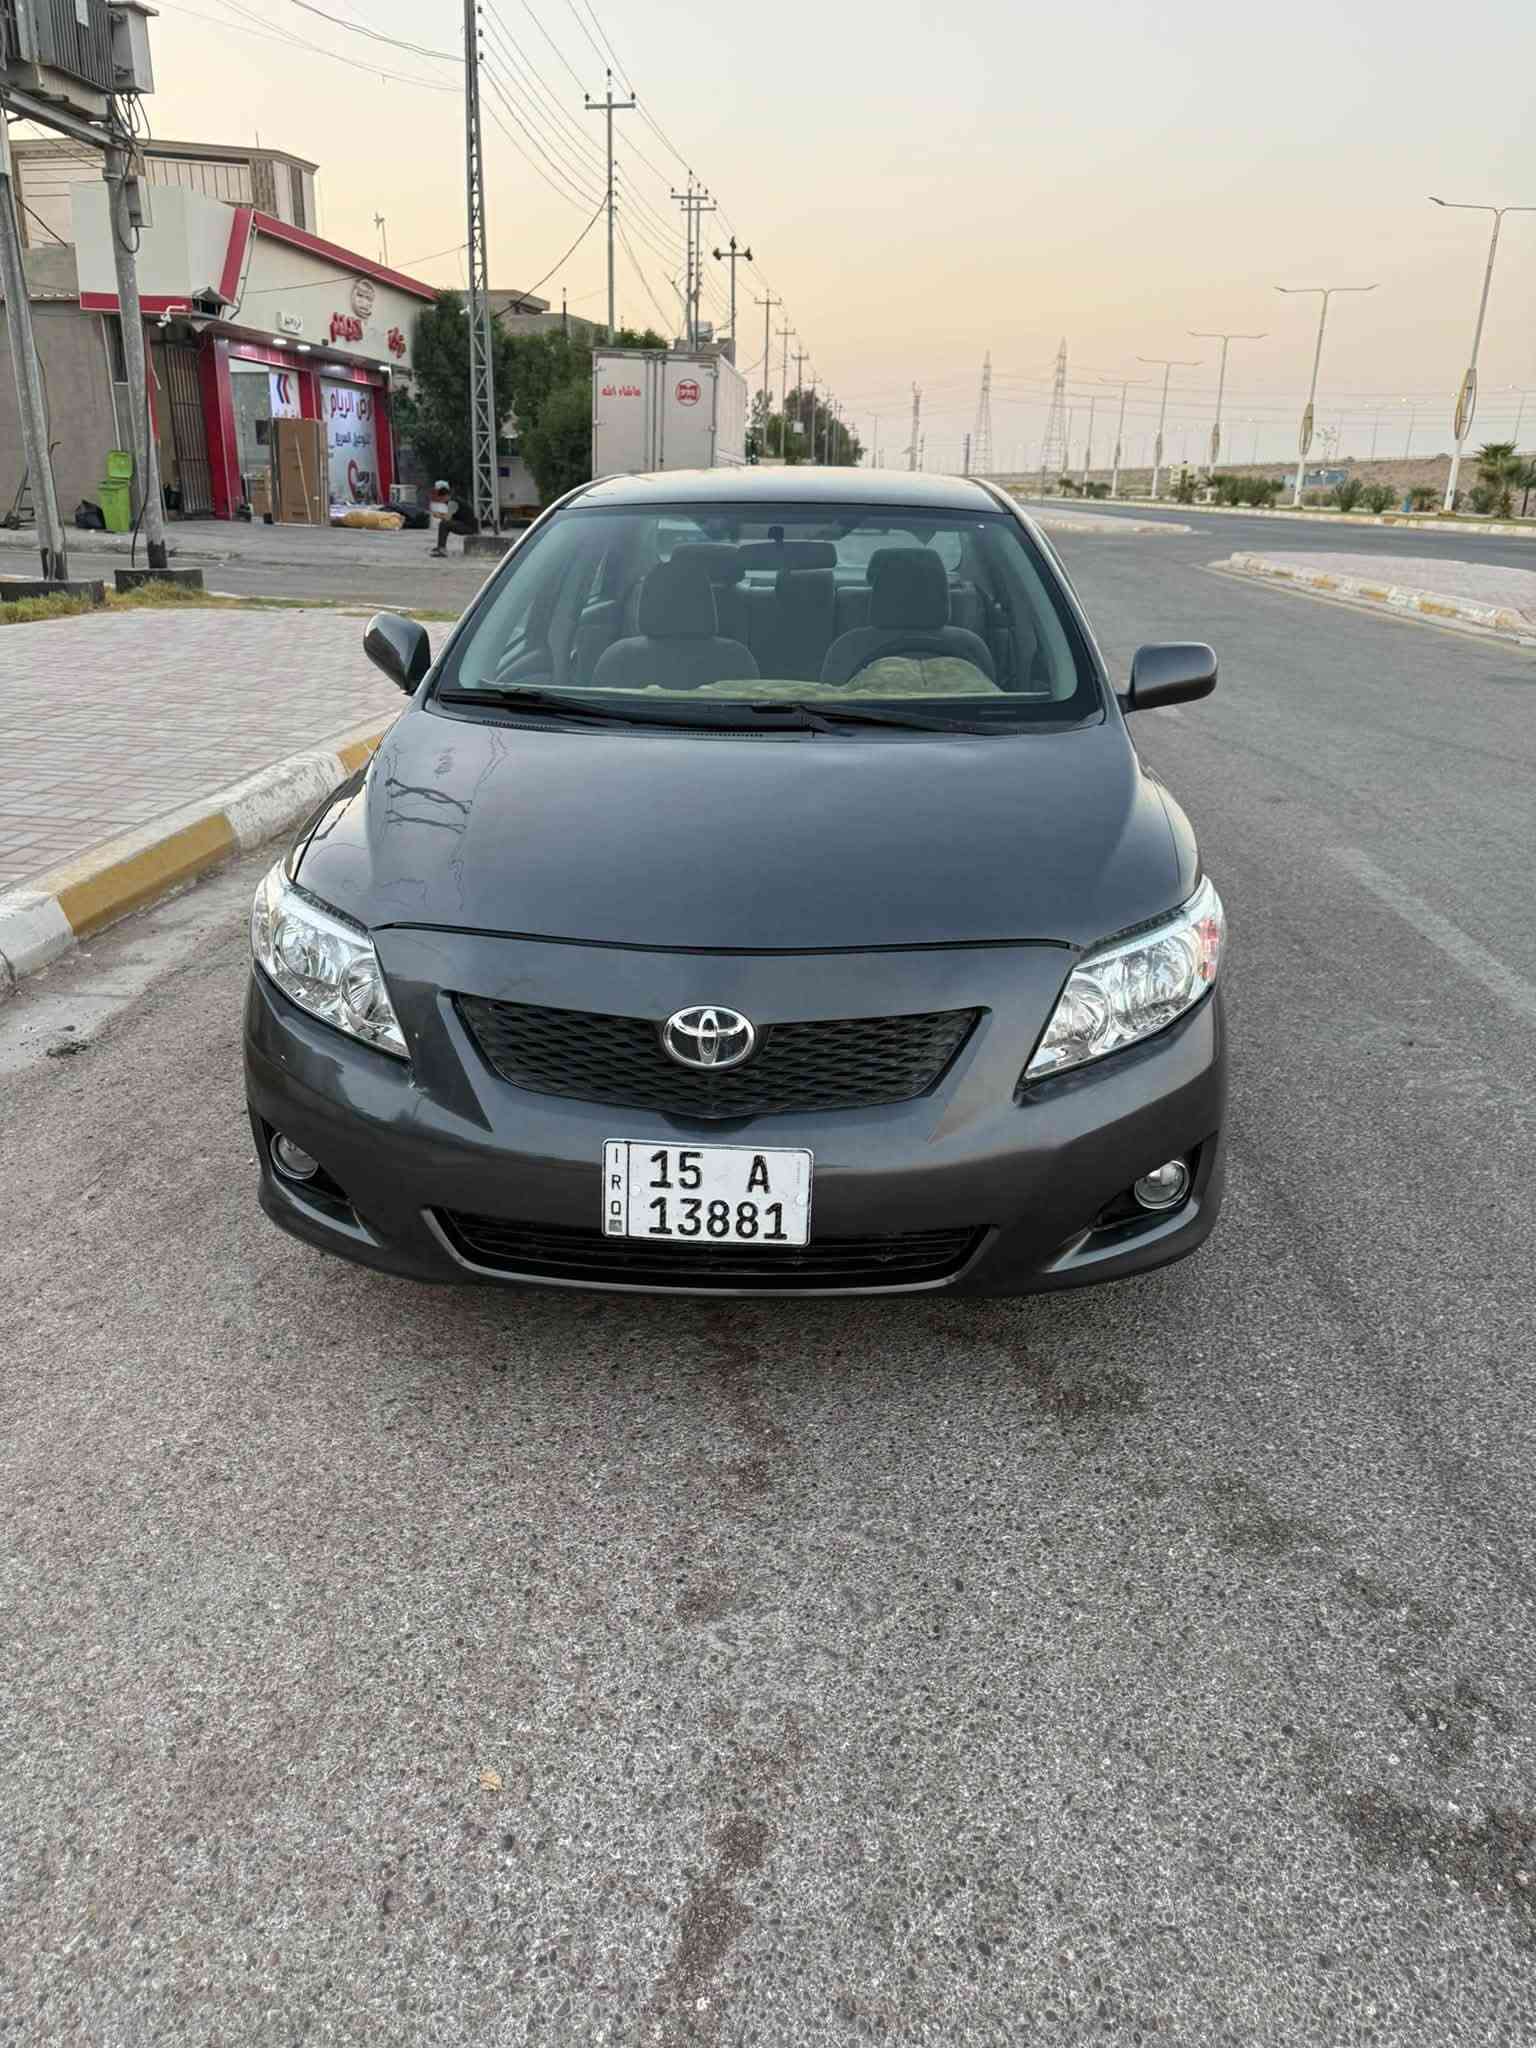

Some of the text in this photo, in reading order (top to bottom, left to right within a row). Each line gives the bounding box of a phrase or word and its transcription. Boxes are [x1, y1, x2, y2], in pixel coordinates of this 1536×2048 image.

[611, 1148, 621, 1216] IRQ
[650, 1150, 704, 1190] 15
[746, 1154, 771, 1194] A
[649, 1196, 788, 1240] 13881
